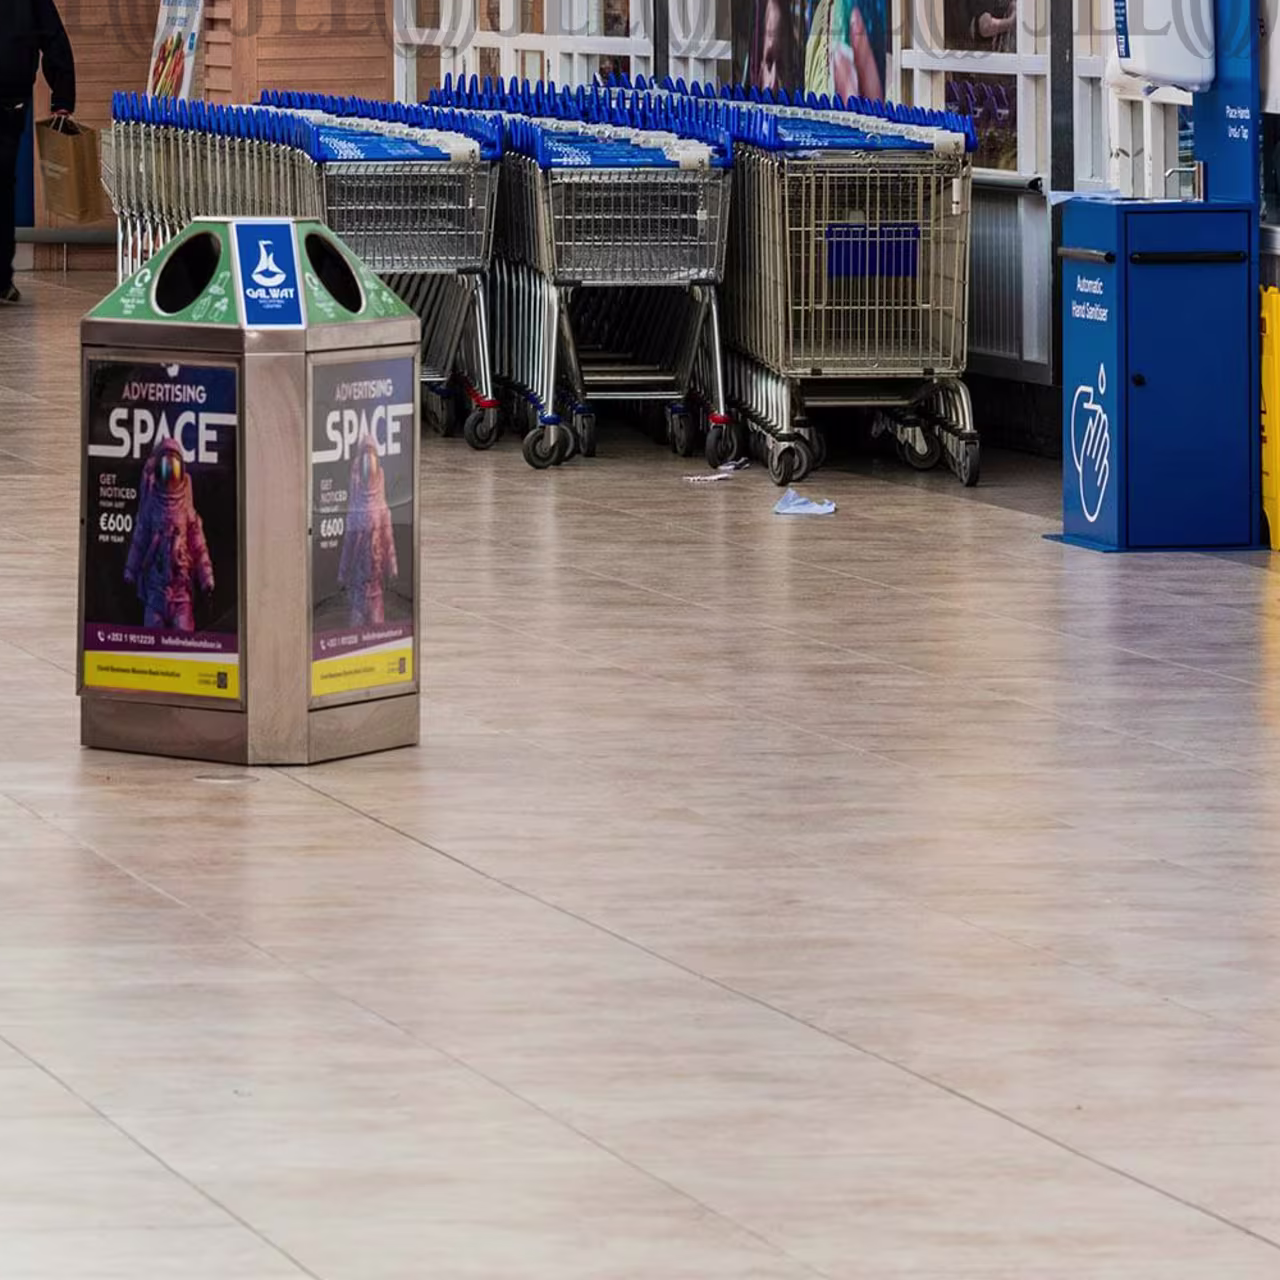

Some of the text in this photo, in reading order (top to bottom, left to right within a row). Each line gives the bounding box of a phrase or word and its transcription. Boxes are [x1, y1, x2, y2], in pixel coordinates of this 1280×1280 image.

[245, 287, 295, 299] GALWAY
[1076, 274, 1103, 295] Automatic
[1072, 299, 1108, 322] Hand Sanitiser
[123, 382, 208, 404] ADVERTISING
[335, 378, 393, 402] ADVERTISING
[88, 407, 238, 464] SPACE
[312, 402, 413, 463] SPACE
[99, 473, 116, 485] GET
[99, 486, 137, 500] NOTICED
[100, 512, 133, 532] €600
